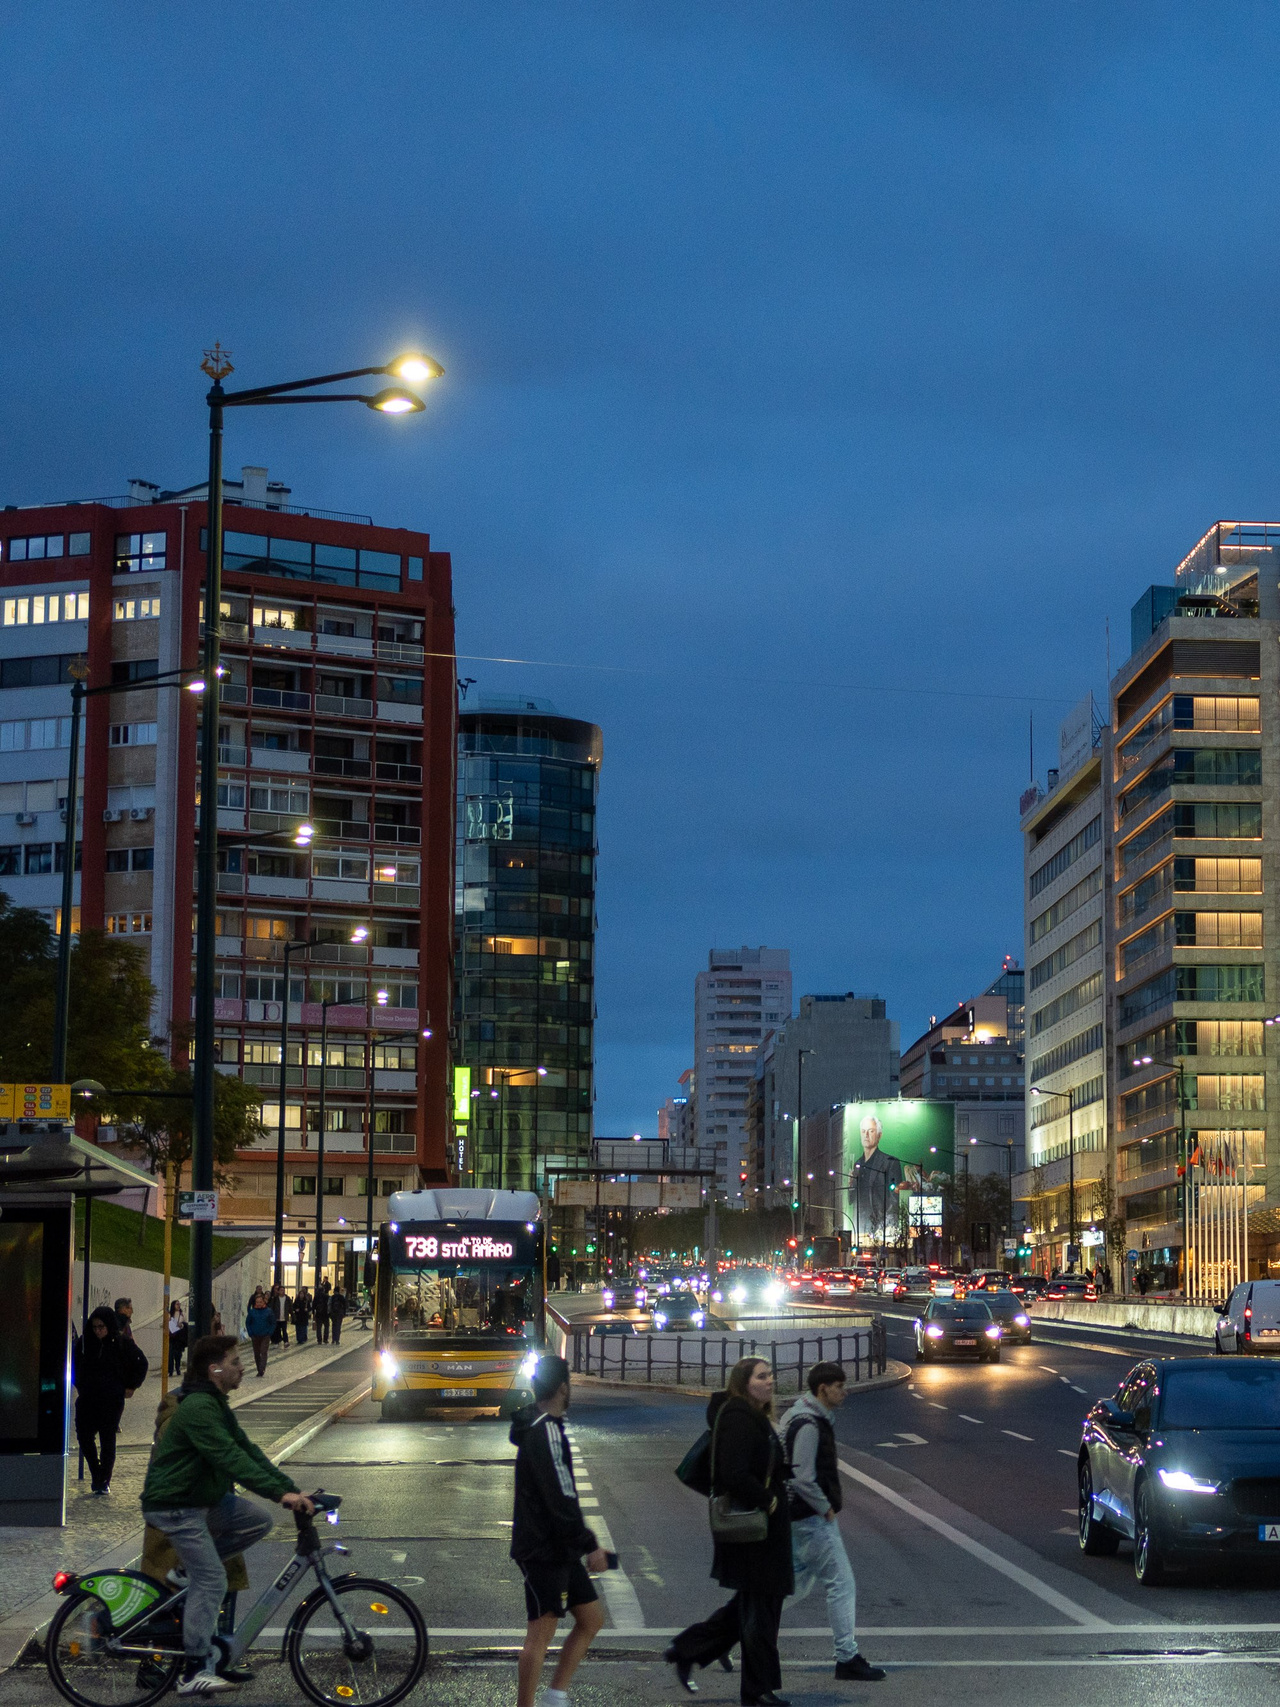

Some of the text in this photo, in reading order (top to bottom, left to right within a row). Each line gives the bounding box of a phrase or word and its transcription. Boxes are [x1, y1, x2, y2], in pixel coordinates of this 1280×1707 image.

[405, 1236, 438, 1258] 738
[462, 1236, 492, 1245] ALTO DE
[441, 1243, 513, 1258] STO. AMARO
